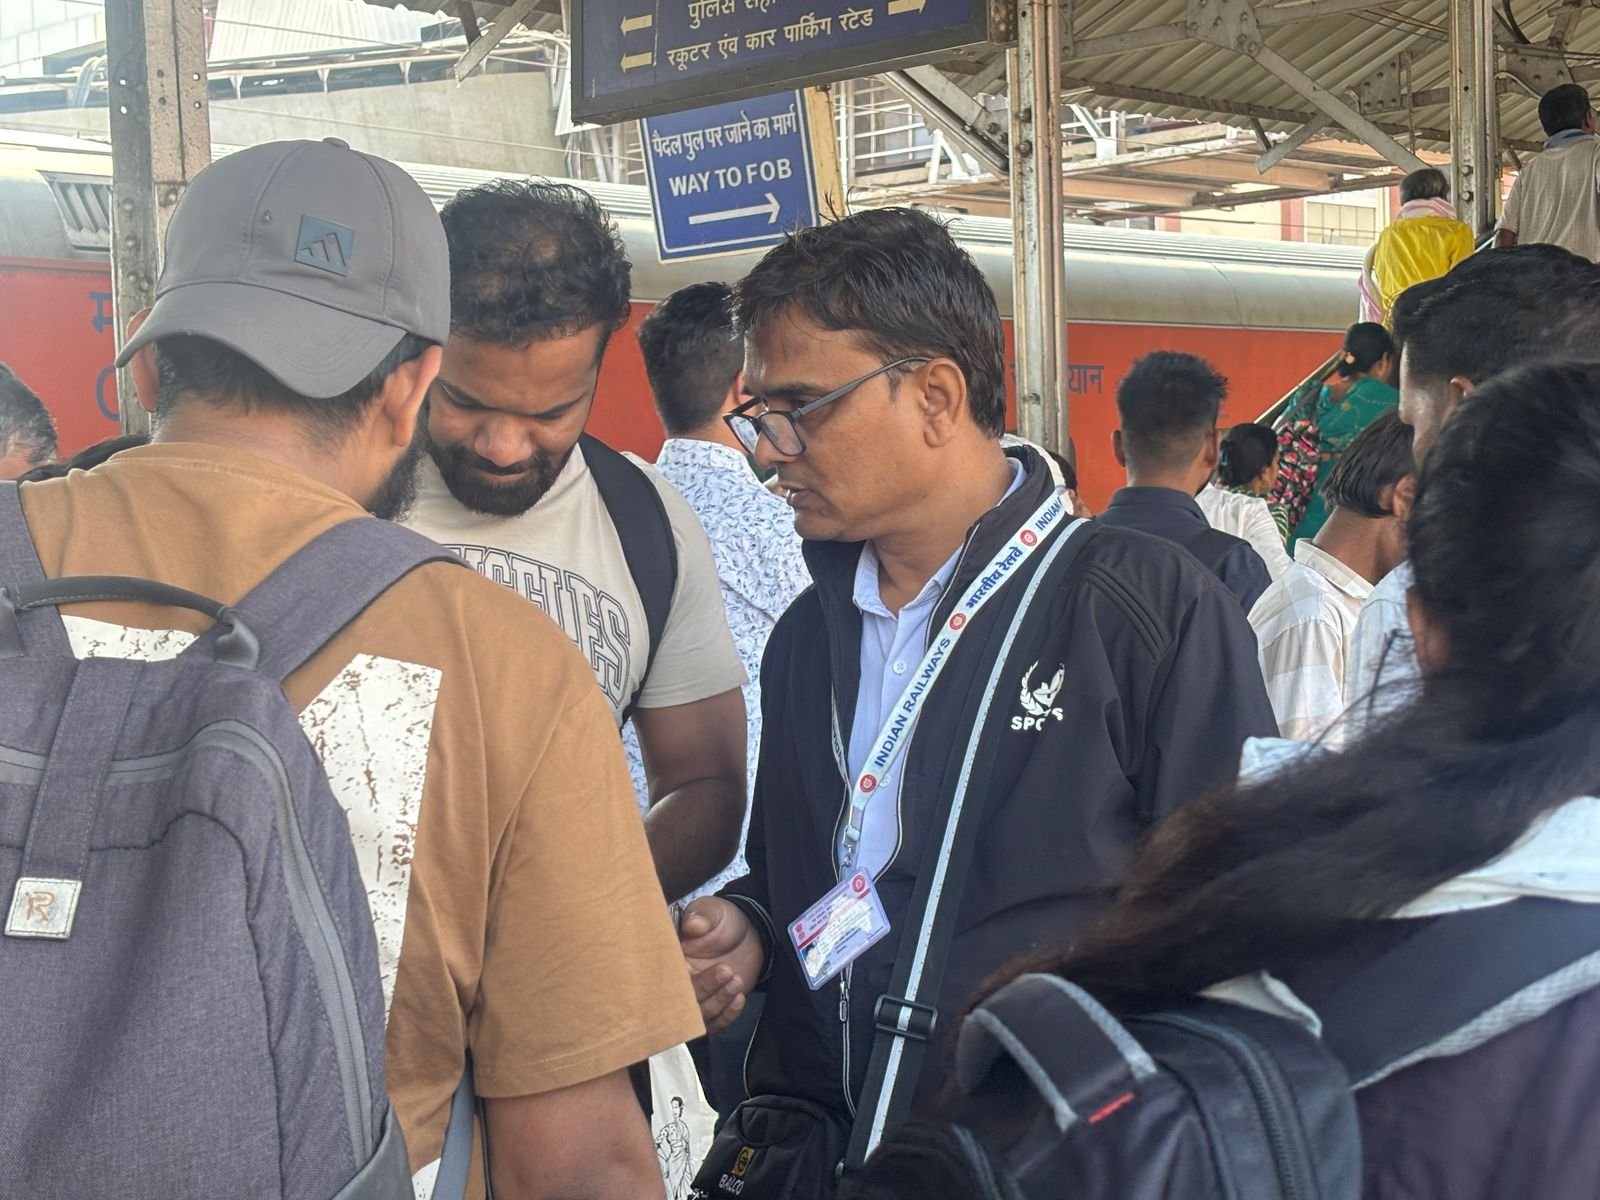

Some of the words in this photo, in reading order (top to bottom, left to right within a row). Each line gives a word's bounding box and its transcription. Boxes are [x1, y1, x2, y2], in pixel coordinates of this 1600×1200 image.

[745, 28, 777, 51] कार
[784, 12, 832, 42] पार्किंग
[651, 128, 682, 157] पैदल
[682, 129, 704, 161] पुल
[705, 126, 723, 148] पर
[724, 110, 752, 144] जाने
[752, 117, 771, 139] का
[771, 103, 797, 135] मार्ग
[668, 171, 710, 197] WAY
[714, 166, 742, 189] TO
[746, 158, 793, 184] FOB
[966, 569, 1004, 608] भारतीय
[995, 546, 1023, 571] रेलवे
[874, 714, 909, 767] INDIAN
[903, 637, 950, 713] RAILWAYS
